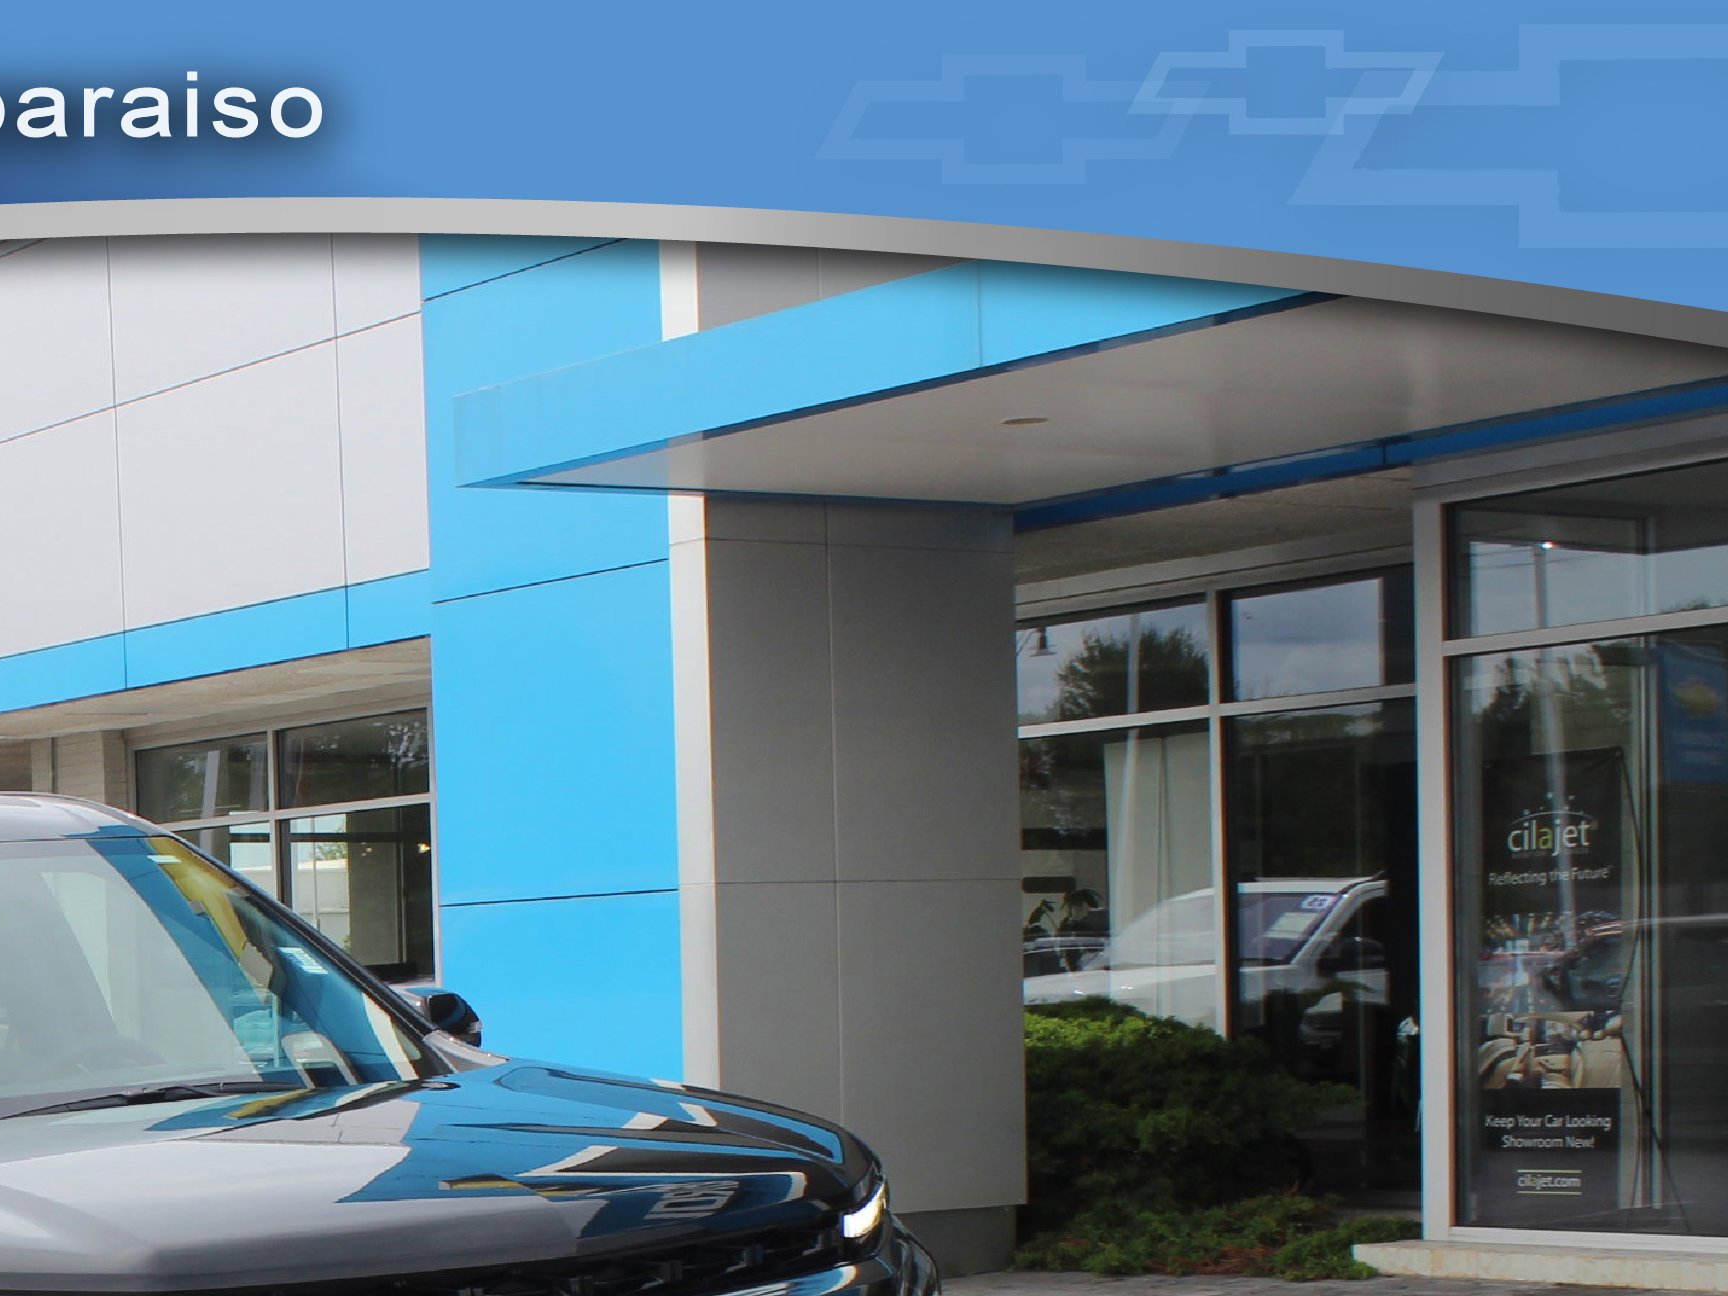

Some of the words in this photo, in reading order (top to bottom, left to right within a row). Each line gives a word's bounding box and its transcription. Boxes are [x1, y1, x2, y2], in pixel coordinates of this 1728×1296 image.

[1507, 818, 1591, 856] cilajet
[1488, 871, 1547, 886] Reflecting
[1484, 1114, 1515, 1129] Keep
[1517, 1114, 1542, 1128] Your
[1544, 1114, 1563, 1128] Car
[1564, 1114, 1612, 1131] Looking
[1501, 1135, 1563, 1148] Showroom
